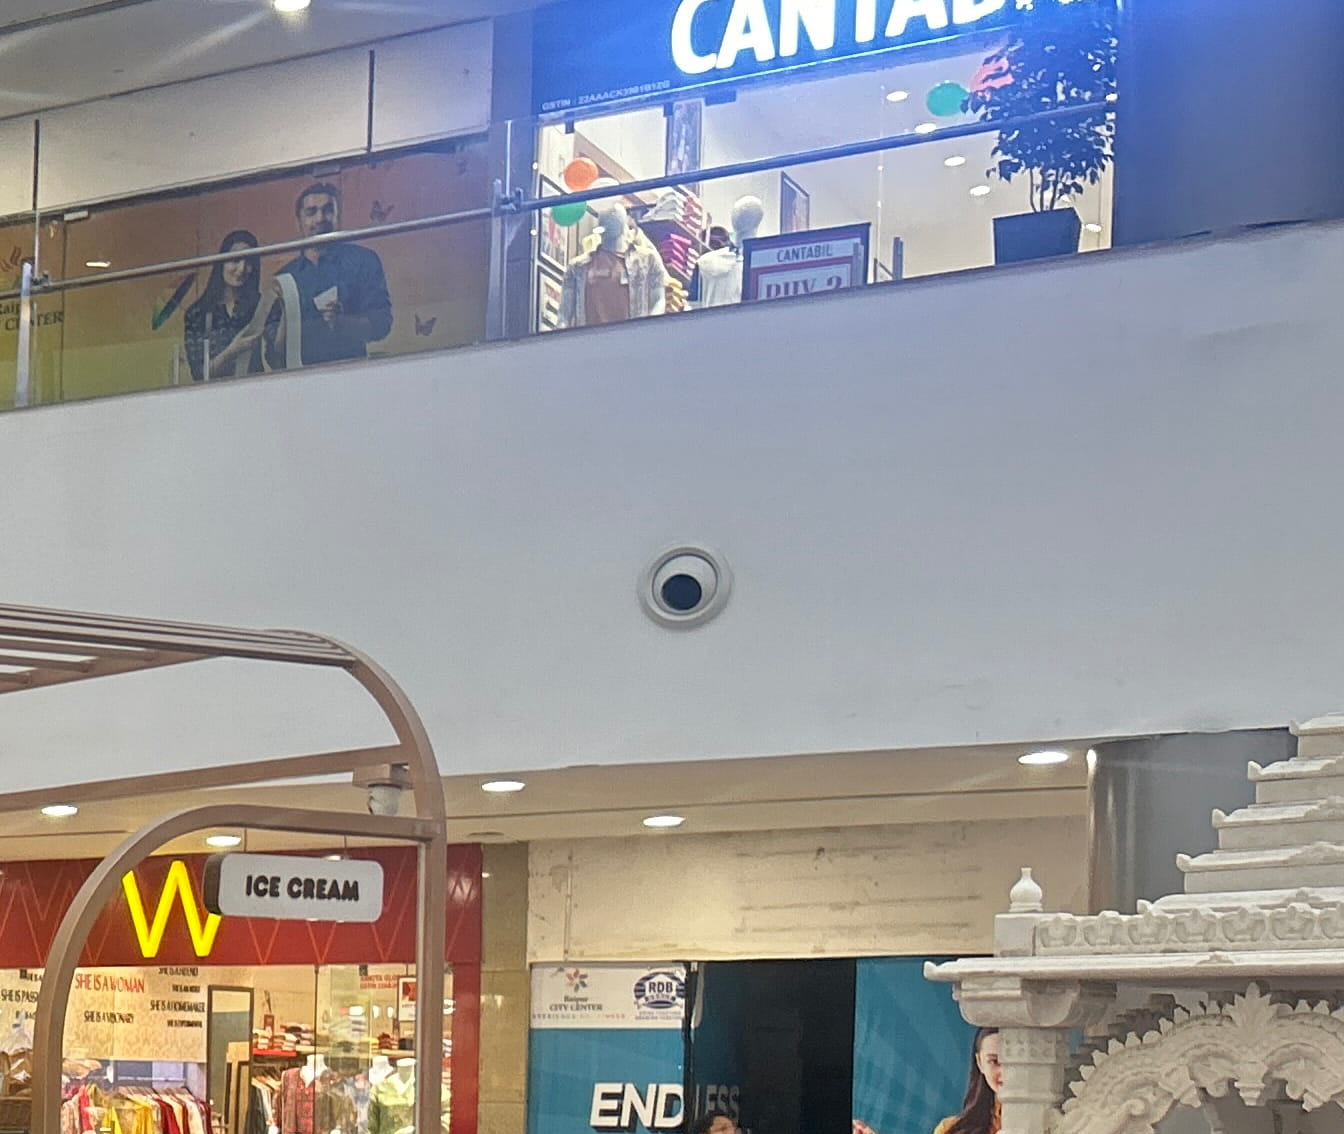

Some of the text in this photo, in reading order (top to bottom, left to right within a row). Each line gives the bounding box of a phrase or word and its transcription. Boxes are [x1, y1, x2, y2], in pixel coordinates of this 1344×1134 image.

[776, 243, 833, 263] CANTABIL
[245, 874, 361, 903] ICE CREAM
[122, 860, 222, 958] W
[648, 980, 673, 994] RDB
